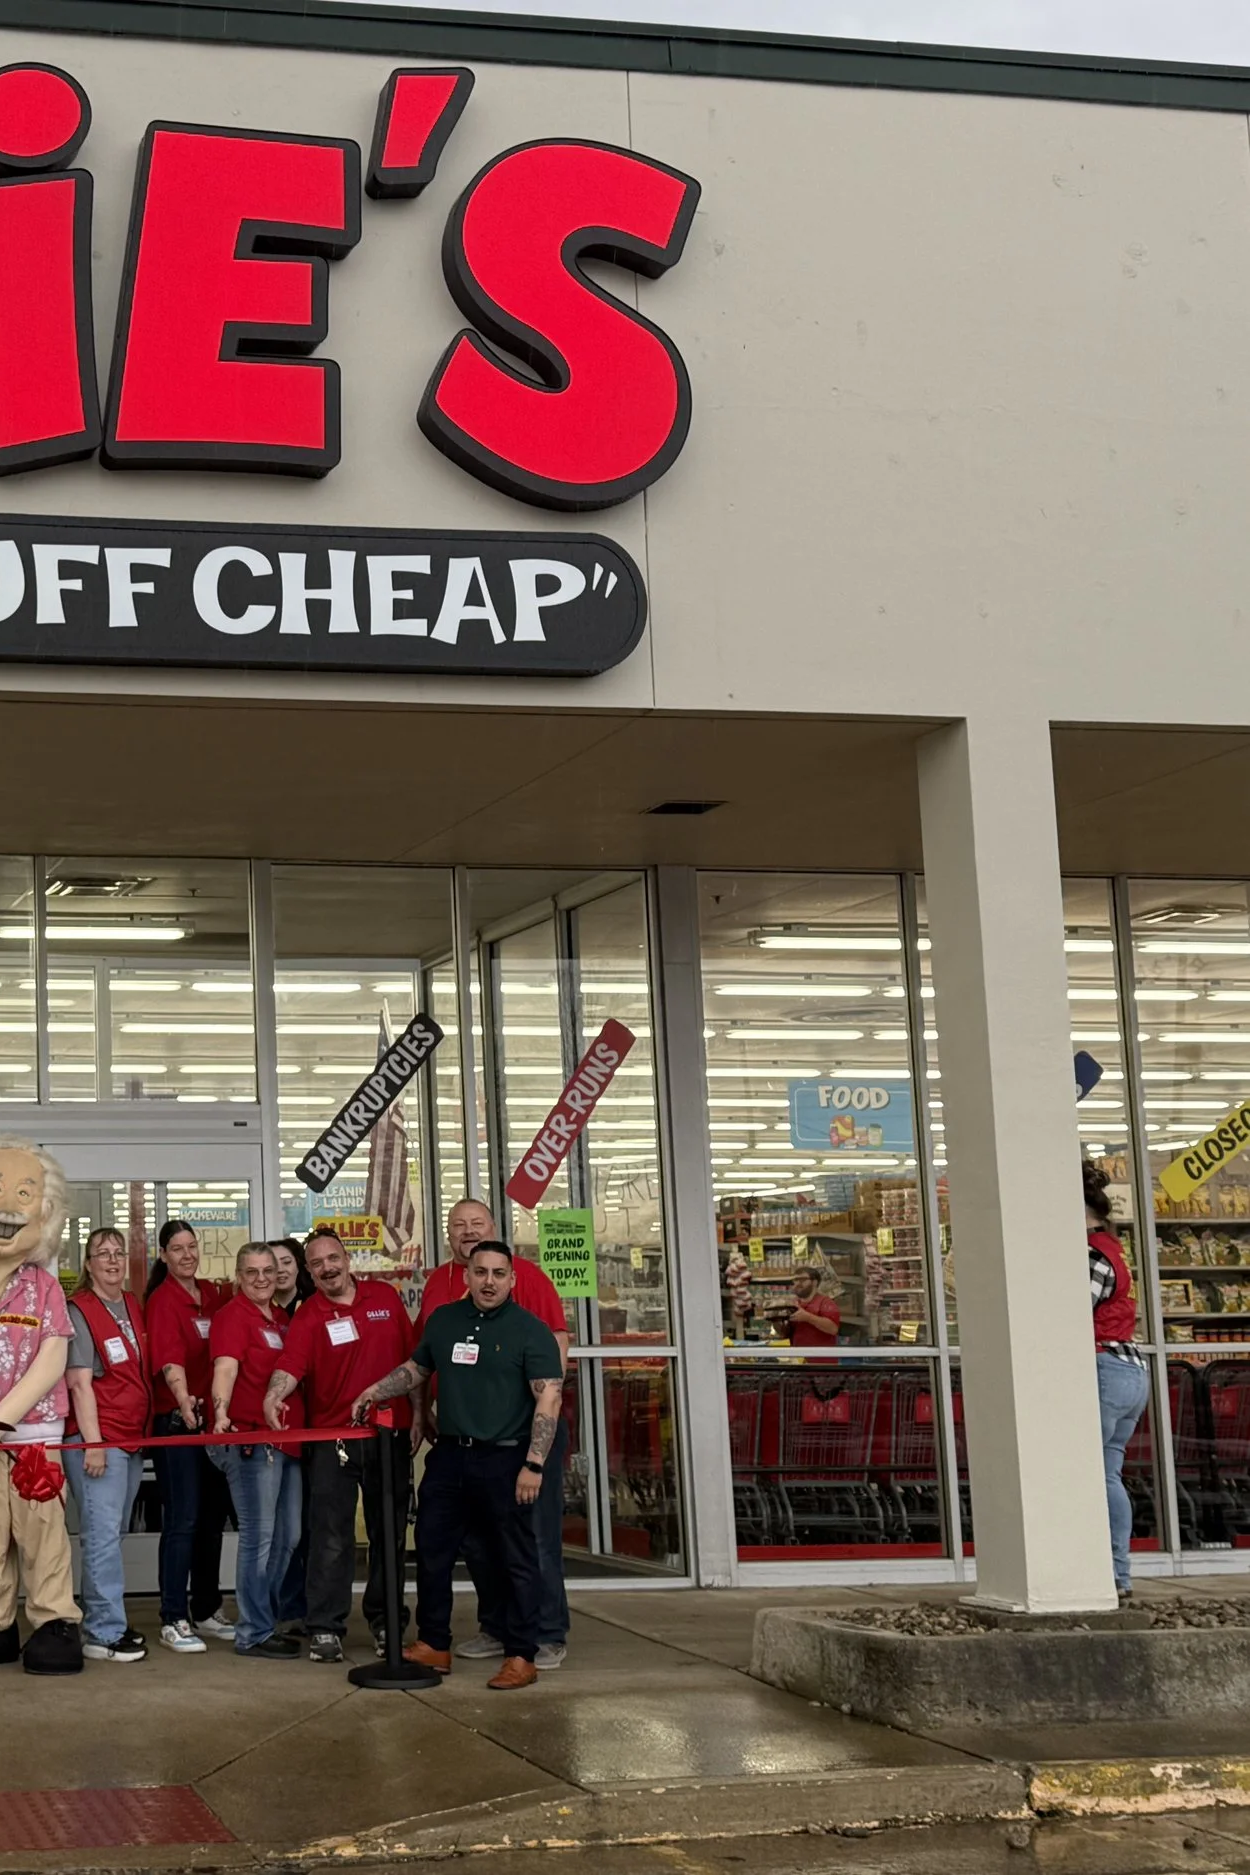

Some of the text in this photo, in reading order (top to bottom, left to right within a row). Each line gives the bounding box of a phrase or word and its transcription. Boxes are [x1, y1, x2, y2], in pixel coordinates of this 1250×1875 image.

[304, 1021, 436, 1183] BANKRUPTCIES
[817, 1085, 890, 1110] FOOD
[522, 1042, 619, 1183] OVER-RUNS
[547, 1238, 585, 1249] GRAND
[543, 1250, 590, 1262] OPENING
[549, 1267, 587, 1280] TODAY
